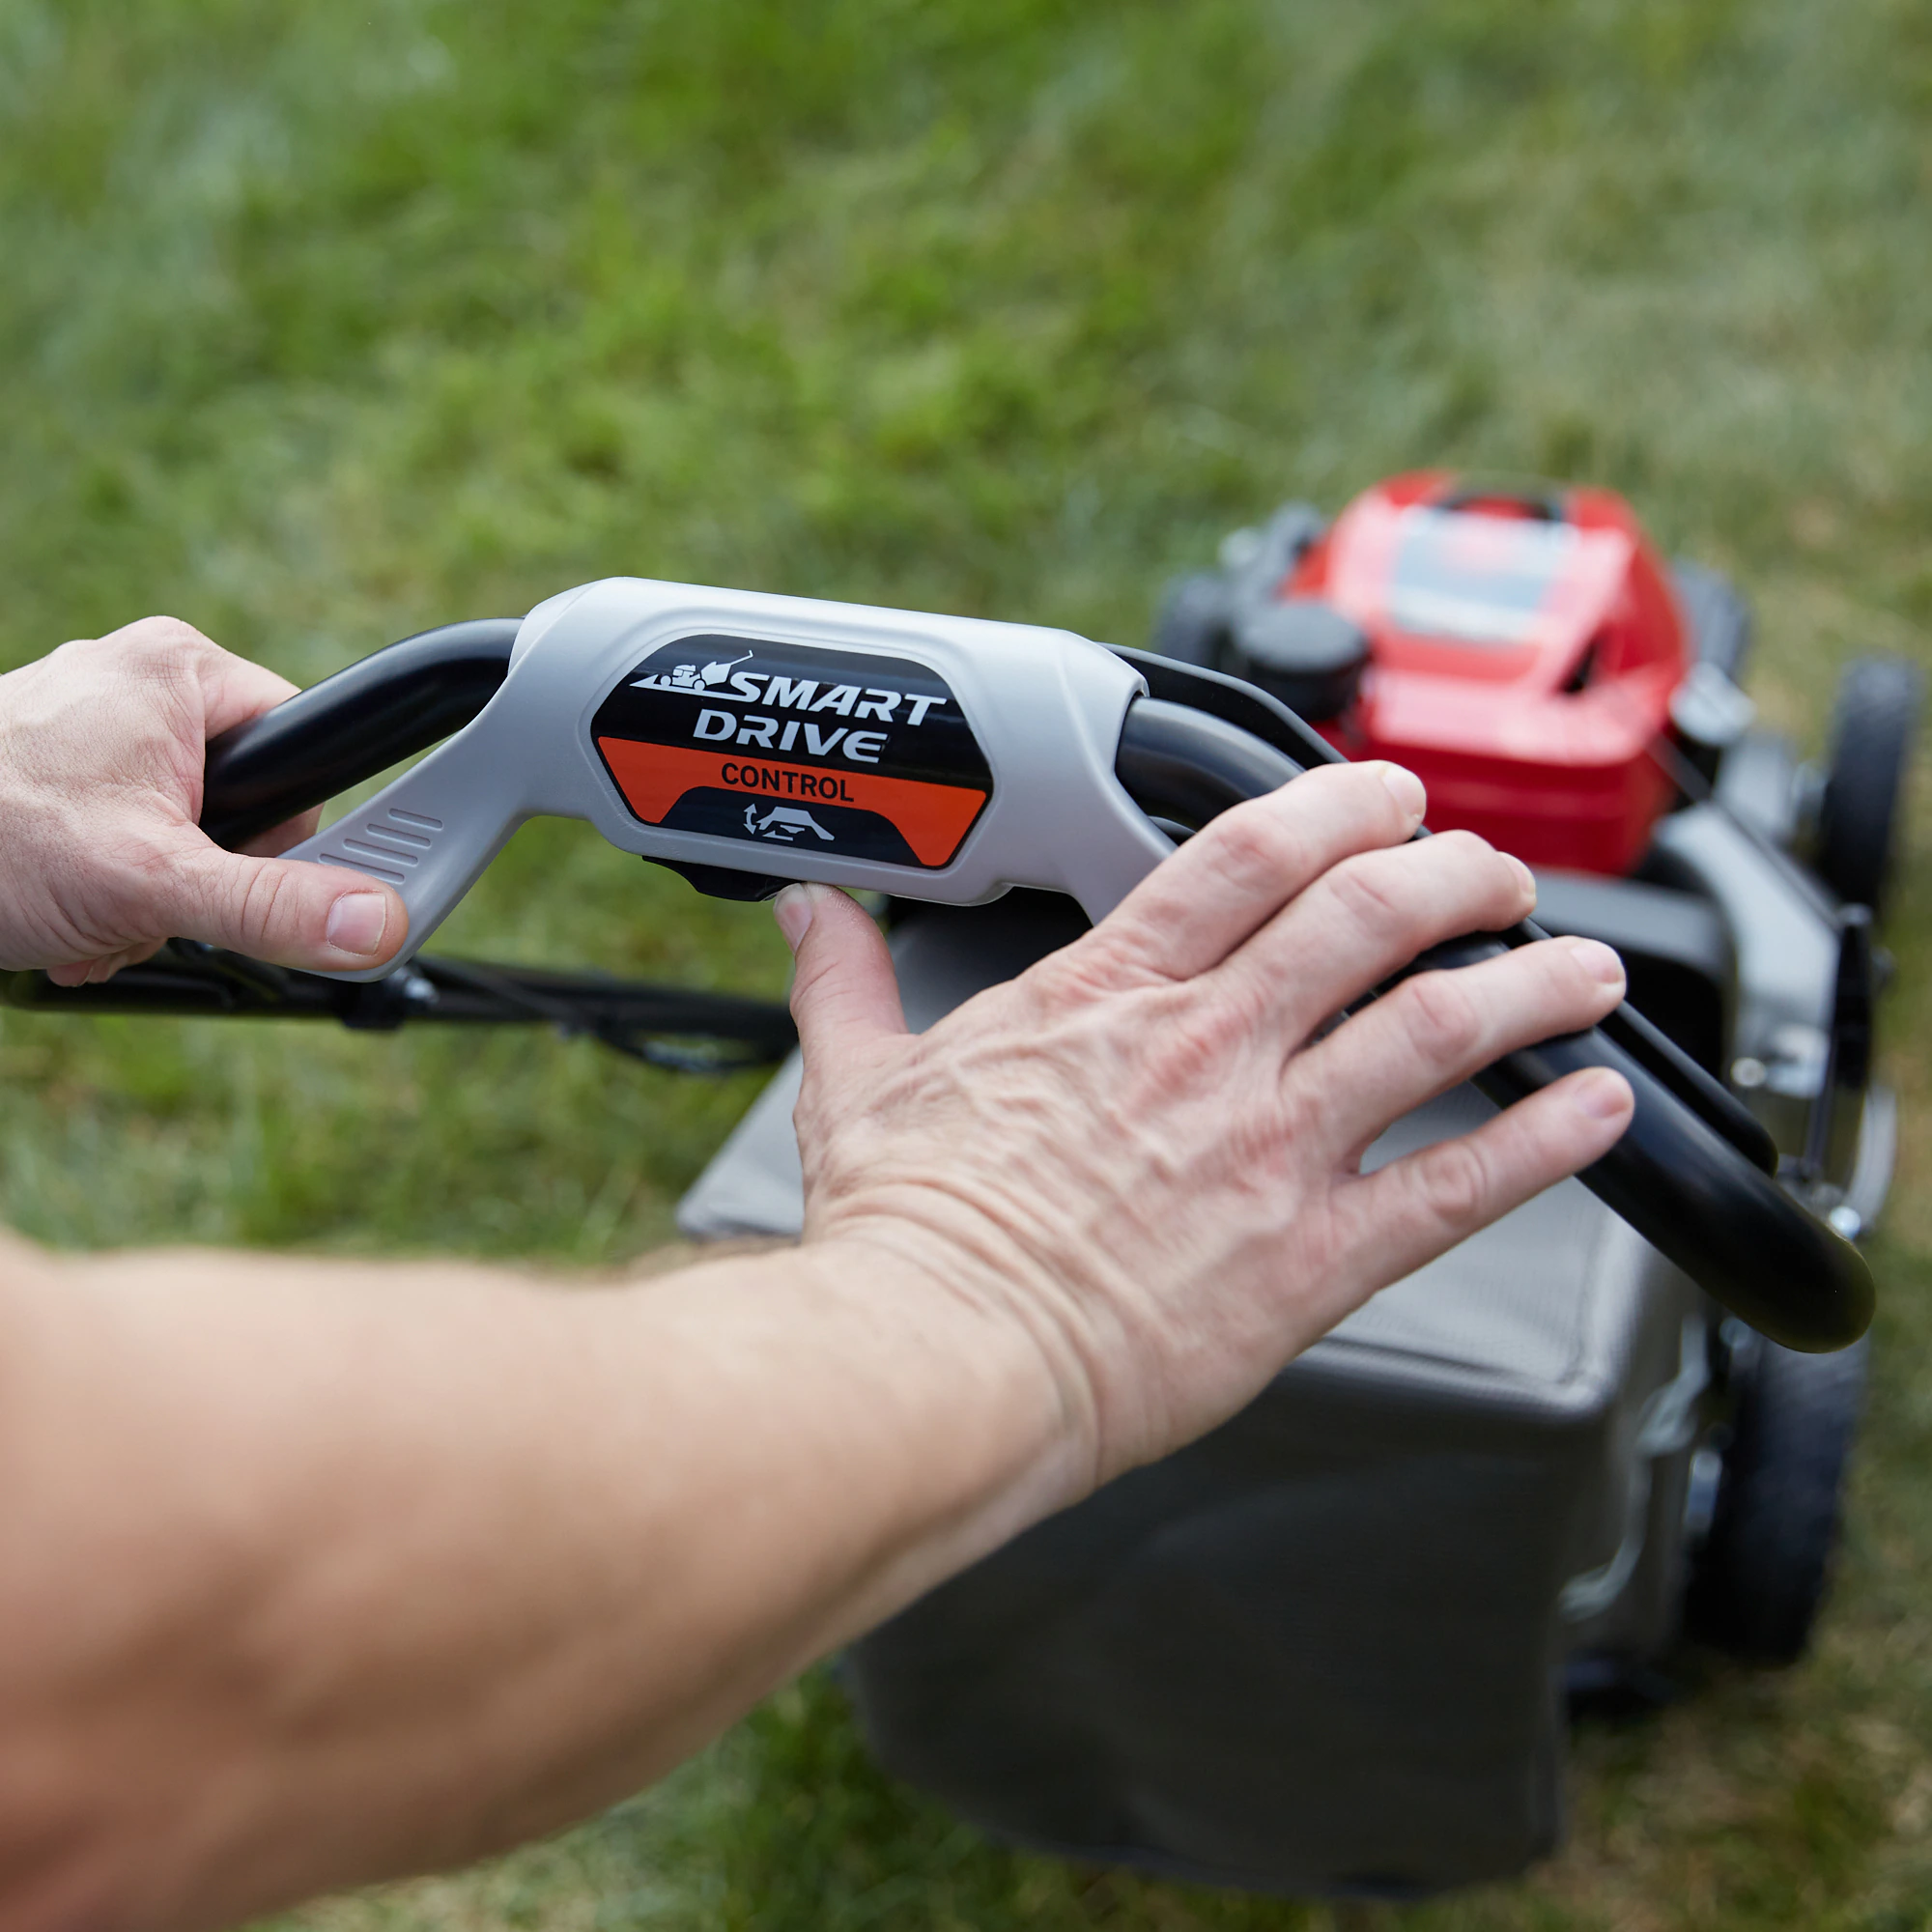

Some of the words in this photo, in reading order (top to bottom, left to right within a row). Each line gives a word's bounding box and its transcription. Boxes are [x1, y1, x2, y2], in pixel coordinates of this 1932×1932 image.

[727, 671, 947, 725] SMART
[693, 709, 889, 763] DRIVE
[721, 762, 854, 803] CONTROL
